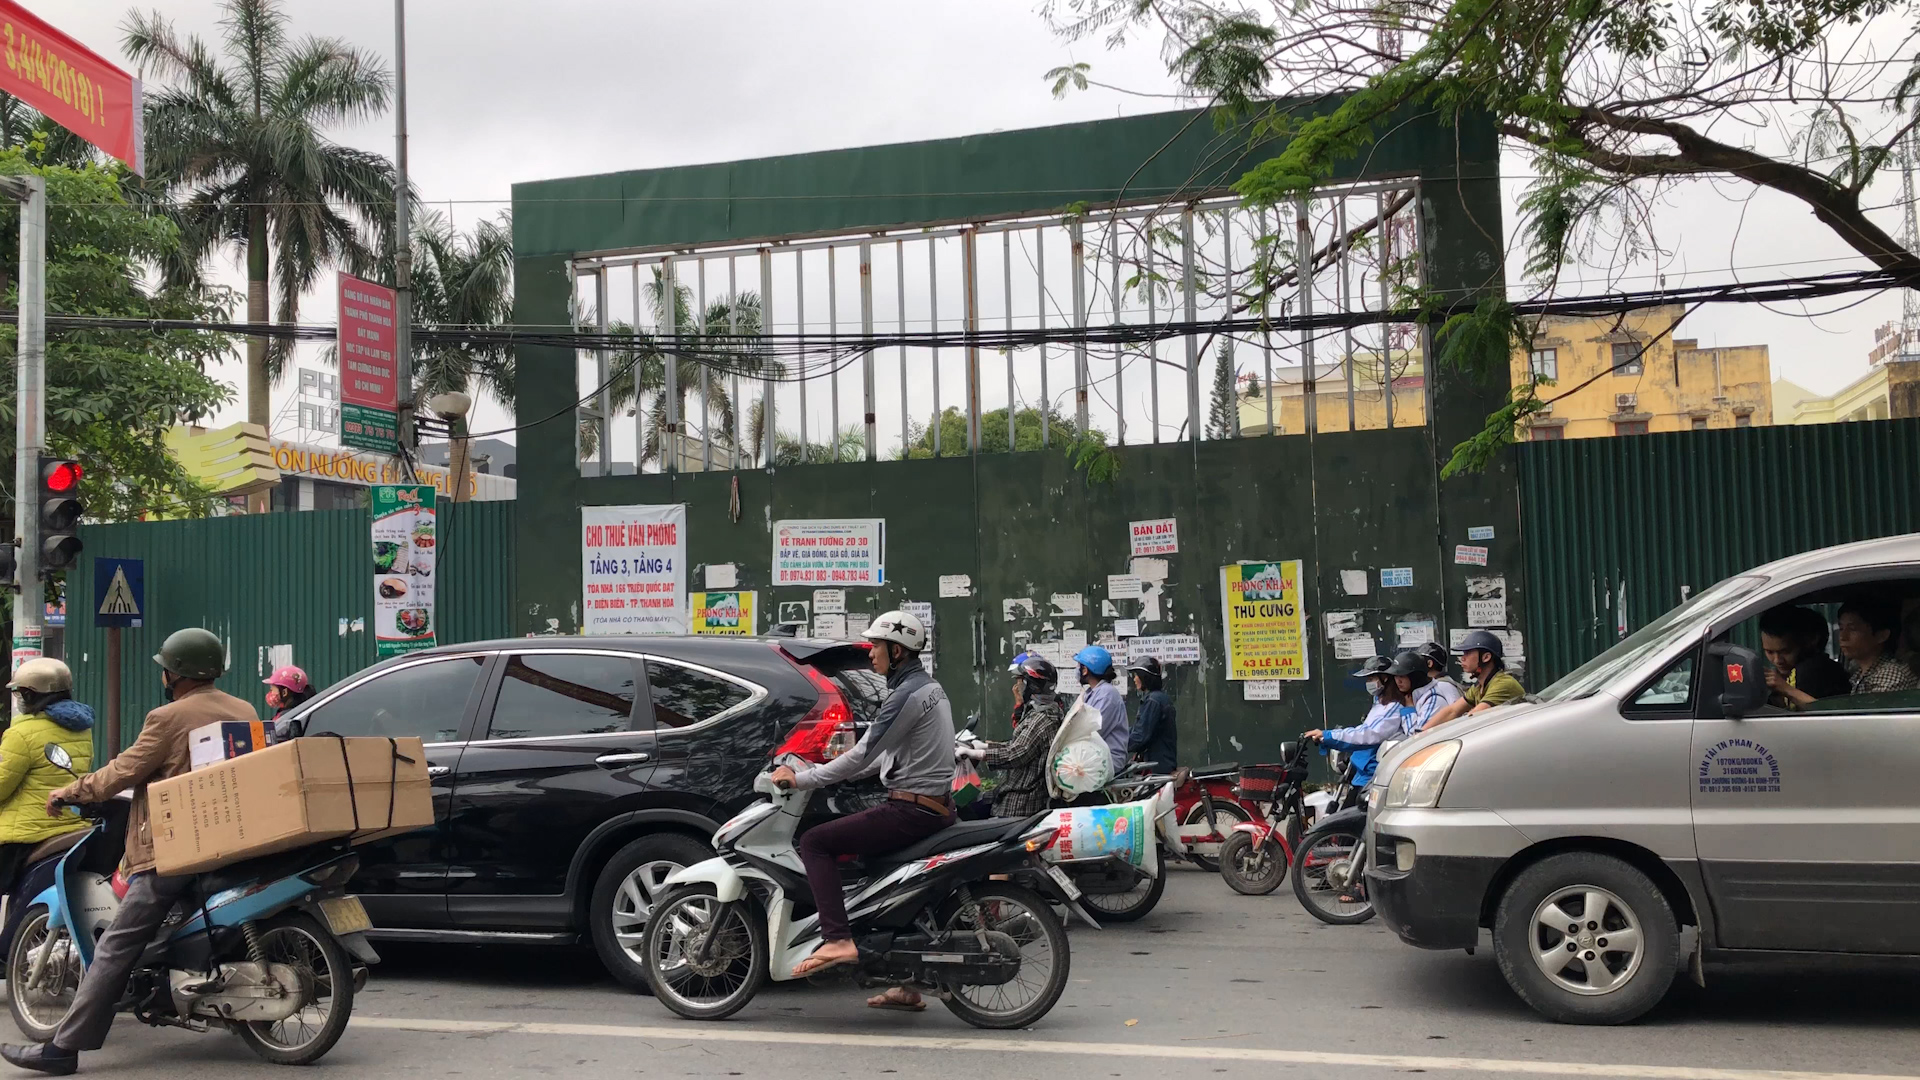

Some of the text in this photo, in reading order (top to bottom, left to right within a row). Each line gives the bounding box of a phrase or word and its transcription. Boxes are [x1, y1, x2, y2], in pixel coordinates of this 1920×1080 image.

[586, 518, 677, 547] CHO THUÊ VĂN PHÒNG
[1133, 520, 1173, 536] BÁN ĐẤT
[780, 535, 868, 547] VẼ TRANH TƯỜNG 2D 3D
[590, 551, 673, 577] TẦNG 3, TẦNG 4
[1232, 576, 1293, 592] PHÒNG KHÁM
[640, 597, 661, 608] THANH
[1234, 600, 1294, 618] THÚ CƯNG
[725, 605, 749, 618] KHÁM
[1243, 657, 1292, 668] 43 LÊ LAI
[1235, 667, 1301, 677] TEL: 678
[1729, 739, 1753, 748] PHAN
[219, 770, 229, 803] QUANTITY
[230, 767, 238, 790] MODEL
